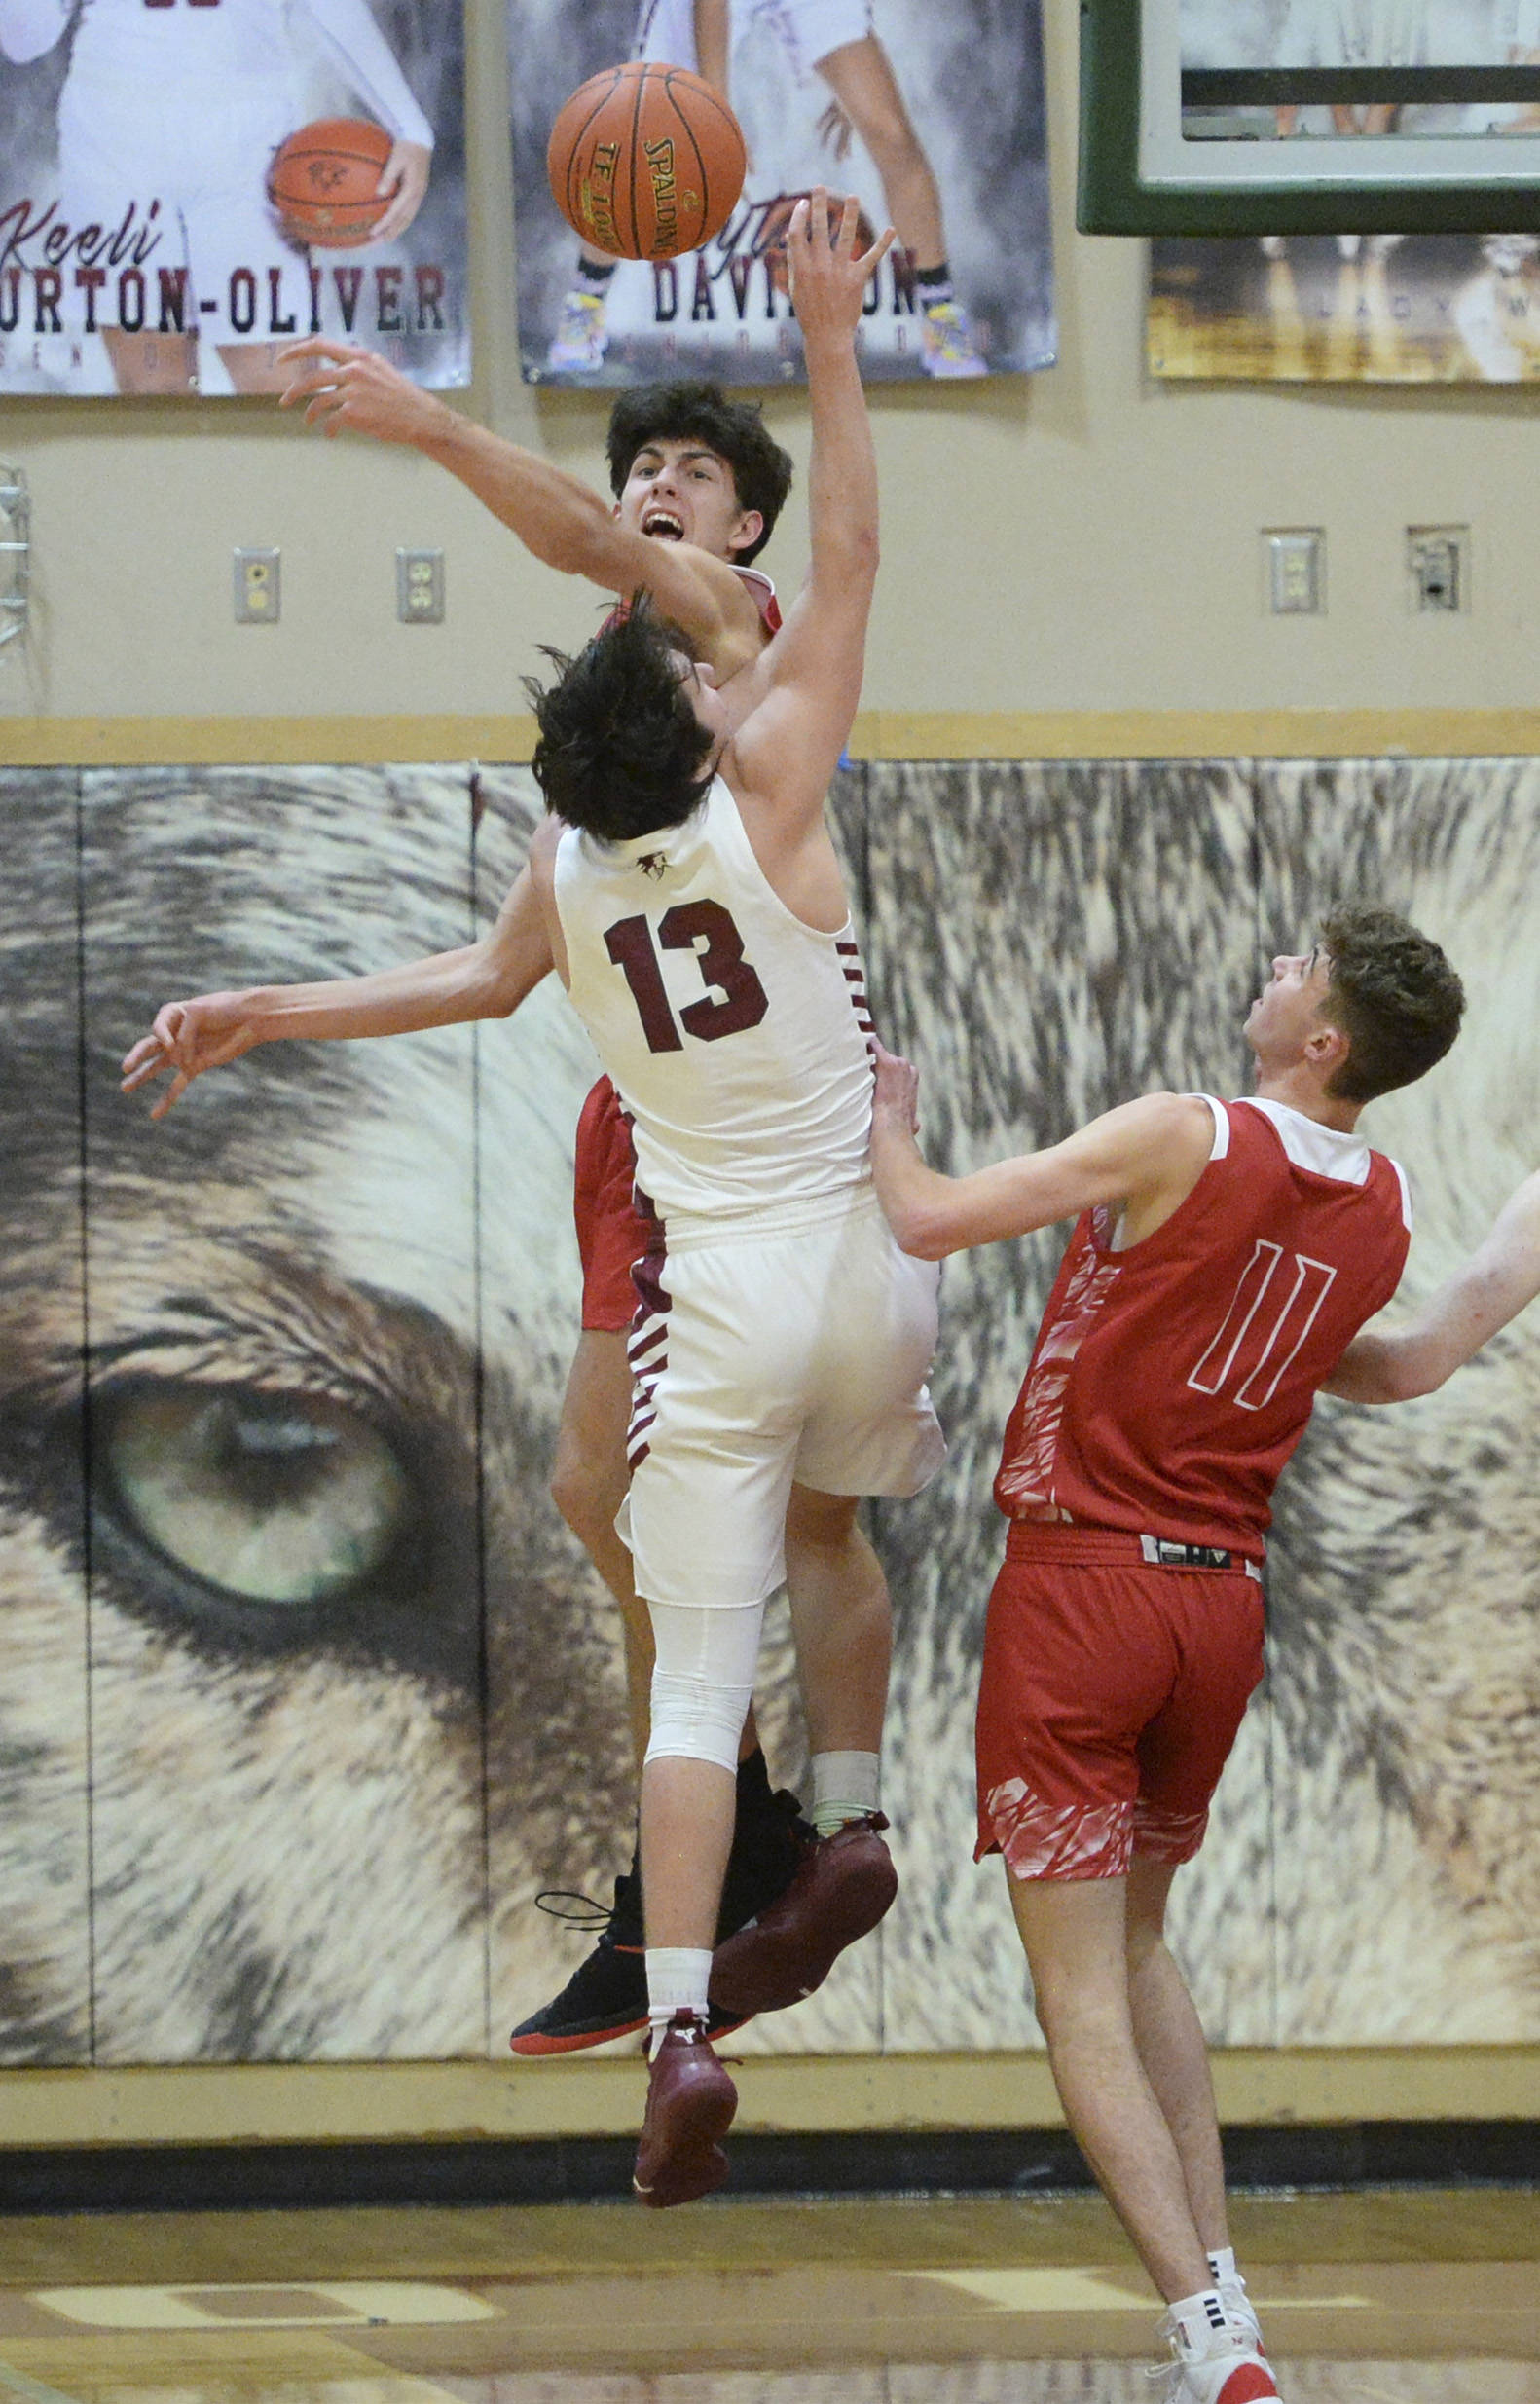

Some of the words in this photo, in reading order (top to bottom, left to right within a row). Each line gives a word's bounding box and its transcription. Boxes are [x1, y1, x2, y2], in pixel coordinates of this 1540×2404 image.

[0, 198, 163, 274] Keeli
[653, 248, 915, 322] DAVION
[603, 898, 769, 1054] 13
[1187, 1238, 1338, 1411] 11
